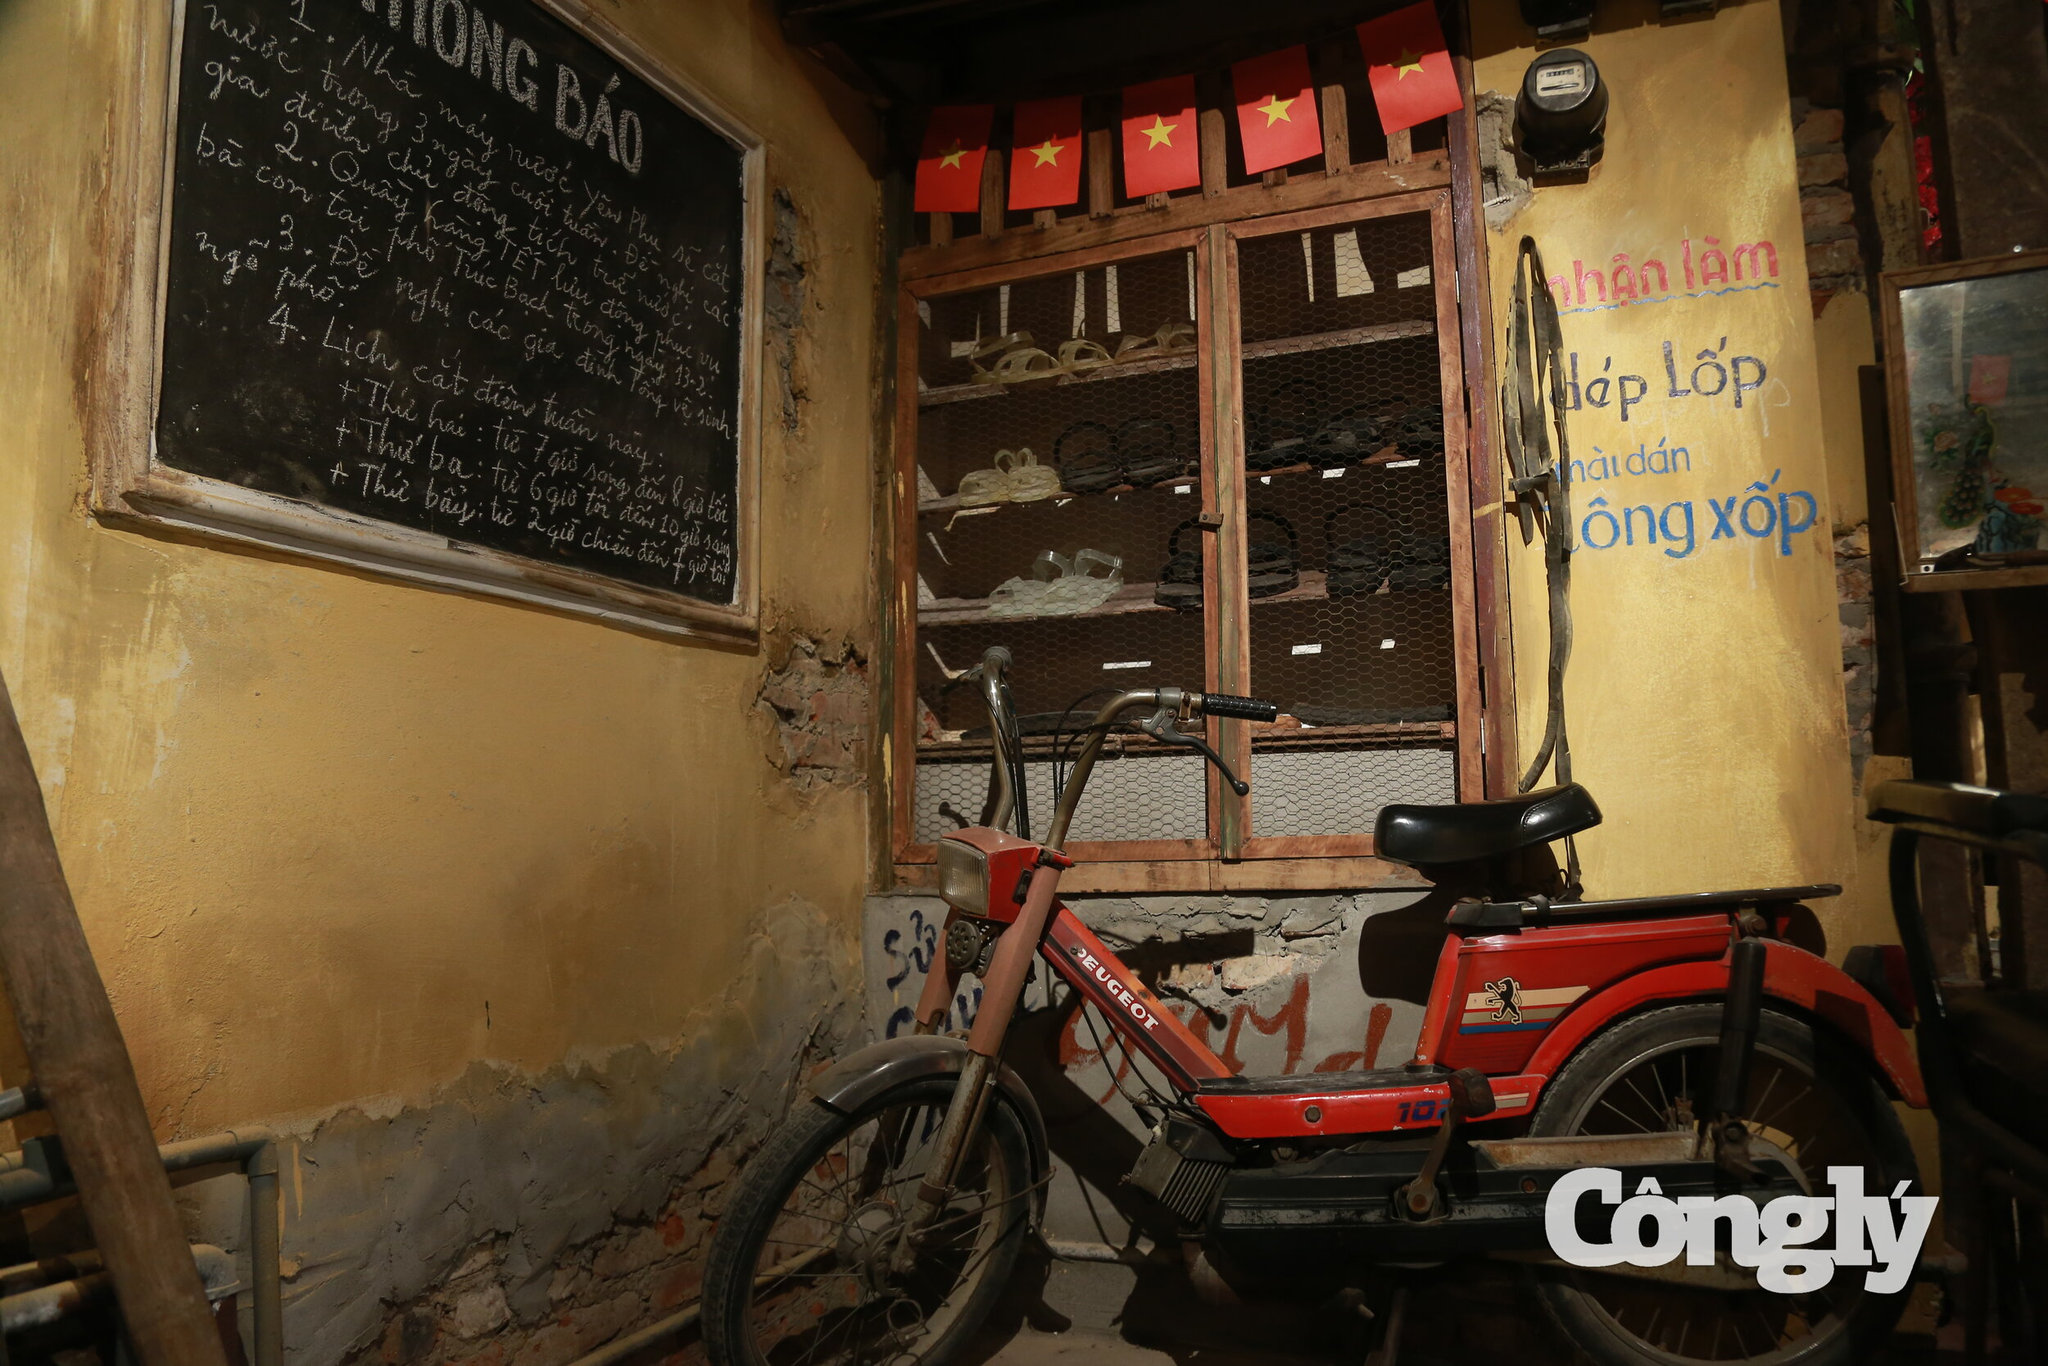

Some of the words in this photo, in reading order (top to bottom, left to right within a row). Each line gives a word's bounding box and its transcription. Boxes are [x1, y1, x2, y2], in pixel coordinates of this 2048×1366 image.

[204, 55, 270, 99] gia
[285, 91, 370, 153] đình
[453, 182, 517, 239] động
[529, 217, 577, 264] tích
[204, 5, 300, 73] nước
[320, 59, 399, 143] trong
[411, 112, 428, 143] 3
[432, 139, 500, 190] ngày
[511, 182, 553, 216] cuối
[657, 273, 696, 310] nghị
[704, 299, 729, 327] các
[343, 35, 421, 97] Nhà
[438, 101, 498, 162] máy
[508, 143, 573, 193] nước
[579, 180, 622, 224] Yên
[672, 245, 701, 272] sẽ
[703, 245, 730, 292] cắt
[555, 63, 643, 174] BÁO
[195, 232, 270, 284] ngõ
[197, 122, 245, 167] bà
[256, 166, 316, 202] con
[327, 190, 369, 233] tại
[454, 245, 497, 288] Trúc
[504, 275, 553, 318] Bạch
[564, 301, 618, 362] trong
[625, 341, 666, 386] ngày
[275, 121, 318, 166] 2.
[330, 151, 414, 222] Quầy
[424, 200, 489, 261] hàng
[500, 233, 546, 280] TẾT
[601, 298, 648, 344] động
[1547, 251, 1670, 307] nhận
[1680, 235, 1780, 290] làm
[268, 303, 306, 344] 4.
[323, 316, 400, 370] Lịch
[413, 349, 468, 396] cắt
[474, 374, 537, 420] điện
[543, 393, 598, 441] tuần
[280, 214, 313, 254] 3.
[329, 234, 380, 278] Đề
[396, 276, 452, 326] nghị
[468, 309, 511, 340] các
[524, 327, 562, 360] gia
[576, 346, 621, 383] đình
[698, 402, 731, 439] sinh
[360, 416, 423, 464] Thứ
[492, 459, 527, 495] từ
[530, 472, 546, 500] 6
[546, 481, 585, 515] giờ
[587, 485, 611, 519] tối
[619, 501, 655, 527] đến
[659, 515, 678, 534] 10
[365, 378, 417, 421] Thứ
[493, 418, 528, 451] từ
[534, 432, 550, 462] 7
[549, 447, 583, 476] giờ
[583, 461, 630, 498] sáng
[635, 475, 666, 504] đến
[673, 475, 683, 506] 8
[683, 485, 703, 520] giờ
[707, 493, 727, 523] tối
[1571, 496, 1698, 558] ông
[1708, 468, 1817, 556] xốp
[1625, 437, 1690, 476] dán
[359, 463, 409, 501] Thứ
[490, 496, 519, 526] từ
[527, 507, 545, 531] 2
[547, 520, 581, 547] giờ
[581, 530, 634, 557] chiều
[637, 541, 670, 567] đến
[672, 548, 686, 584] 7
